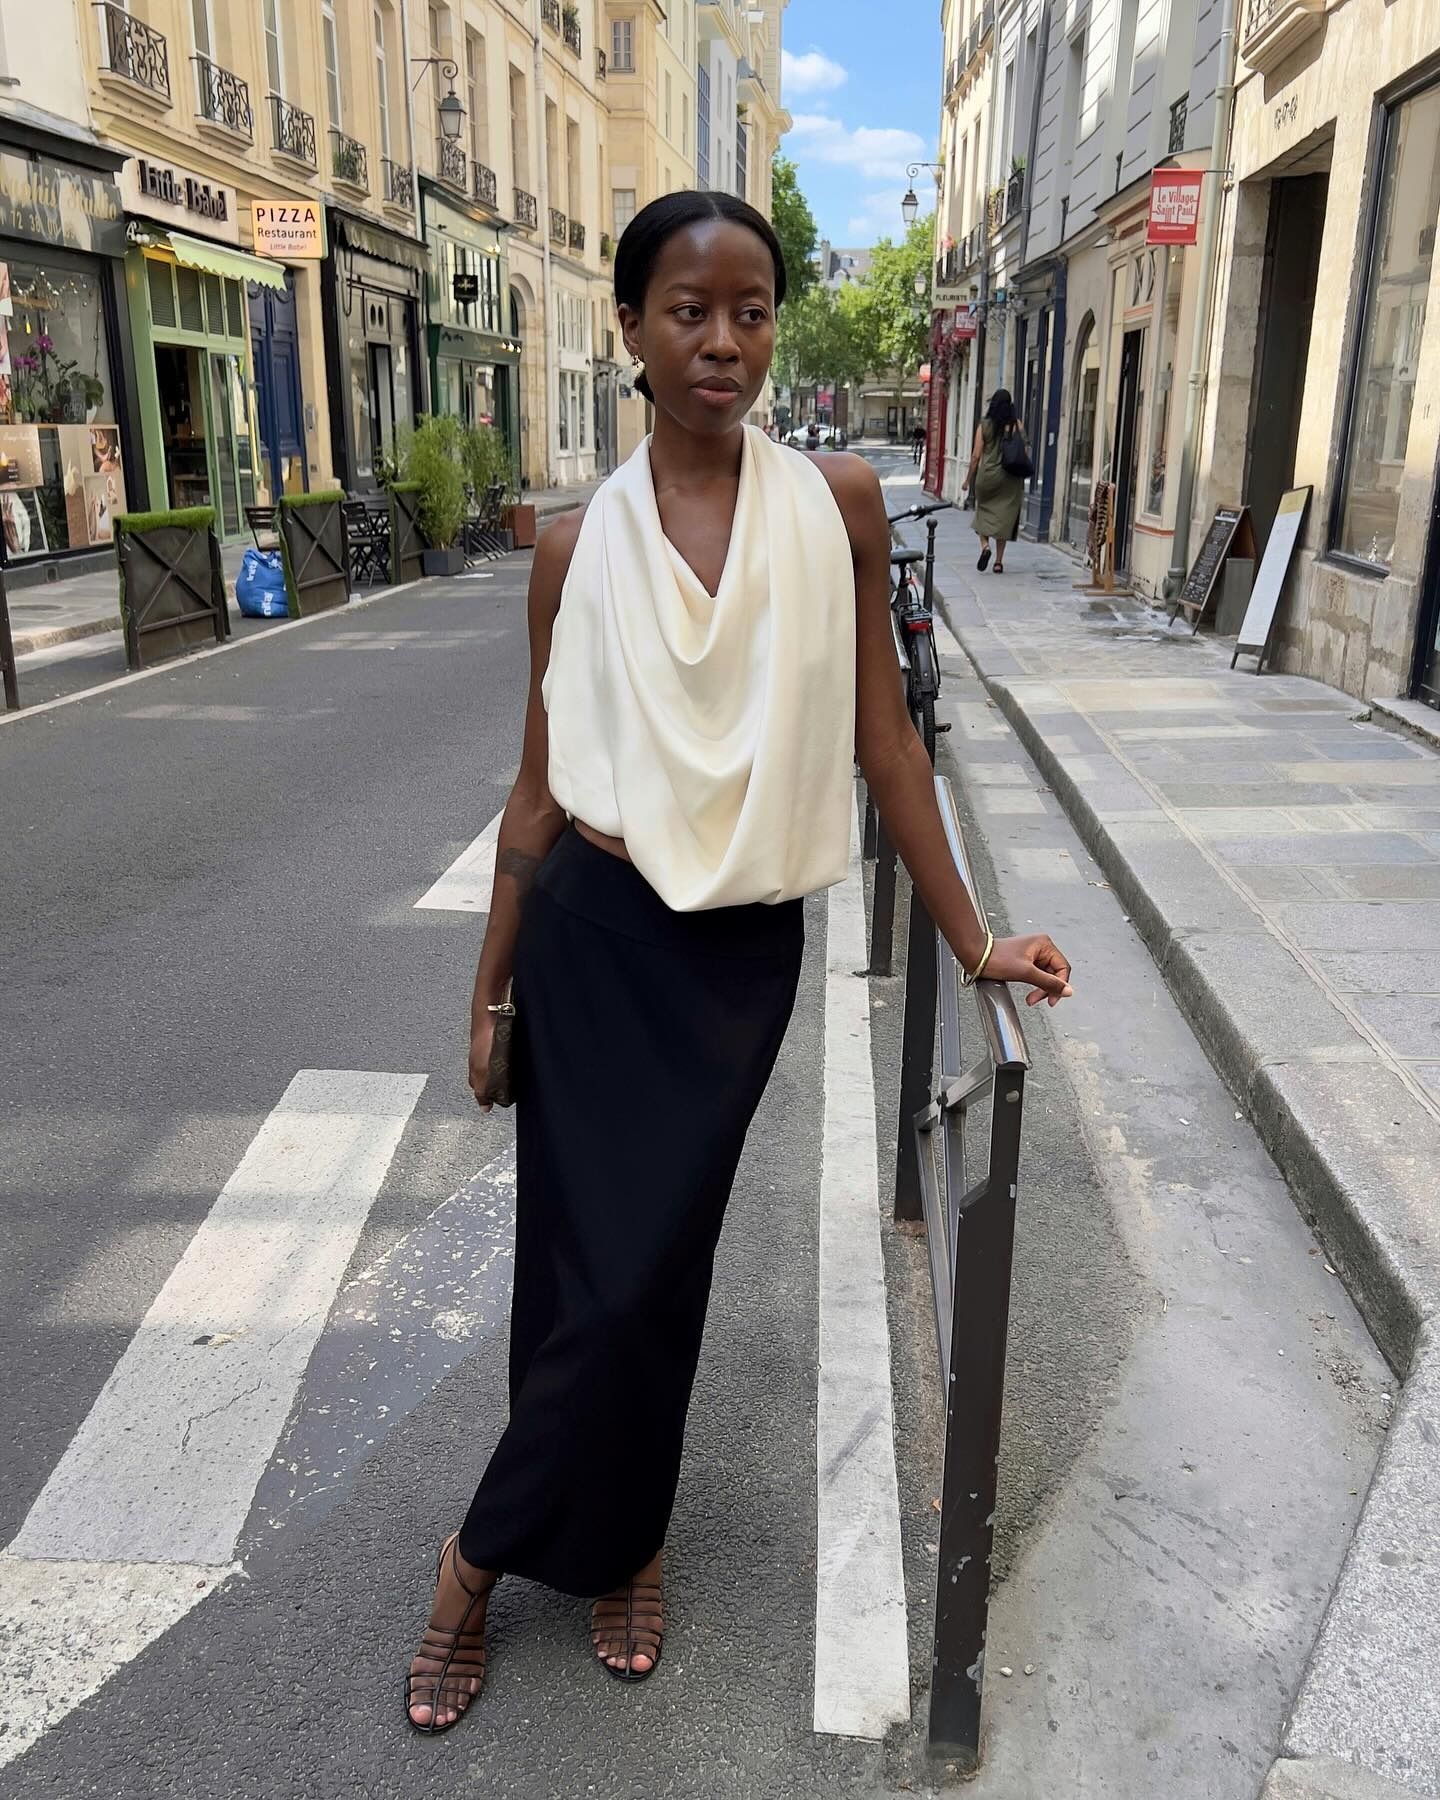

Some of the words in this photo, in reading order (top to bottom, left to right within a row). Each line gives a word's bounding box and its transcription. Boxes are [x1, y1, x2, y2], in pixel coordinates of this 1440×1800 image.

[138, 160, 184, 205] Little
[185, 177, 228, 221] Babel
[1157, 190, 1167, 203] Le
[1169, 191, 1195, 206] Village
[256, 207, 316, 223] PIZZA
[1156, 204, 1176, 216] Saint
[1177, 205, 1194, 216] Paul
[257, 227, 317, 239] Restaurant
